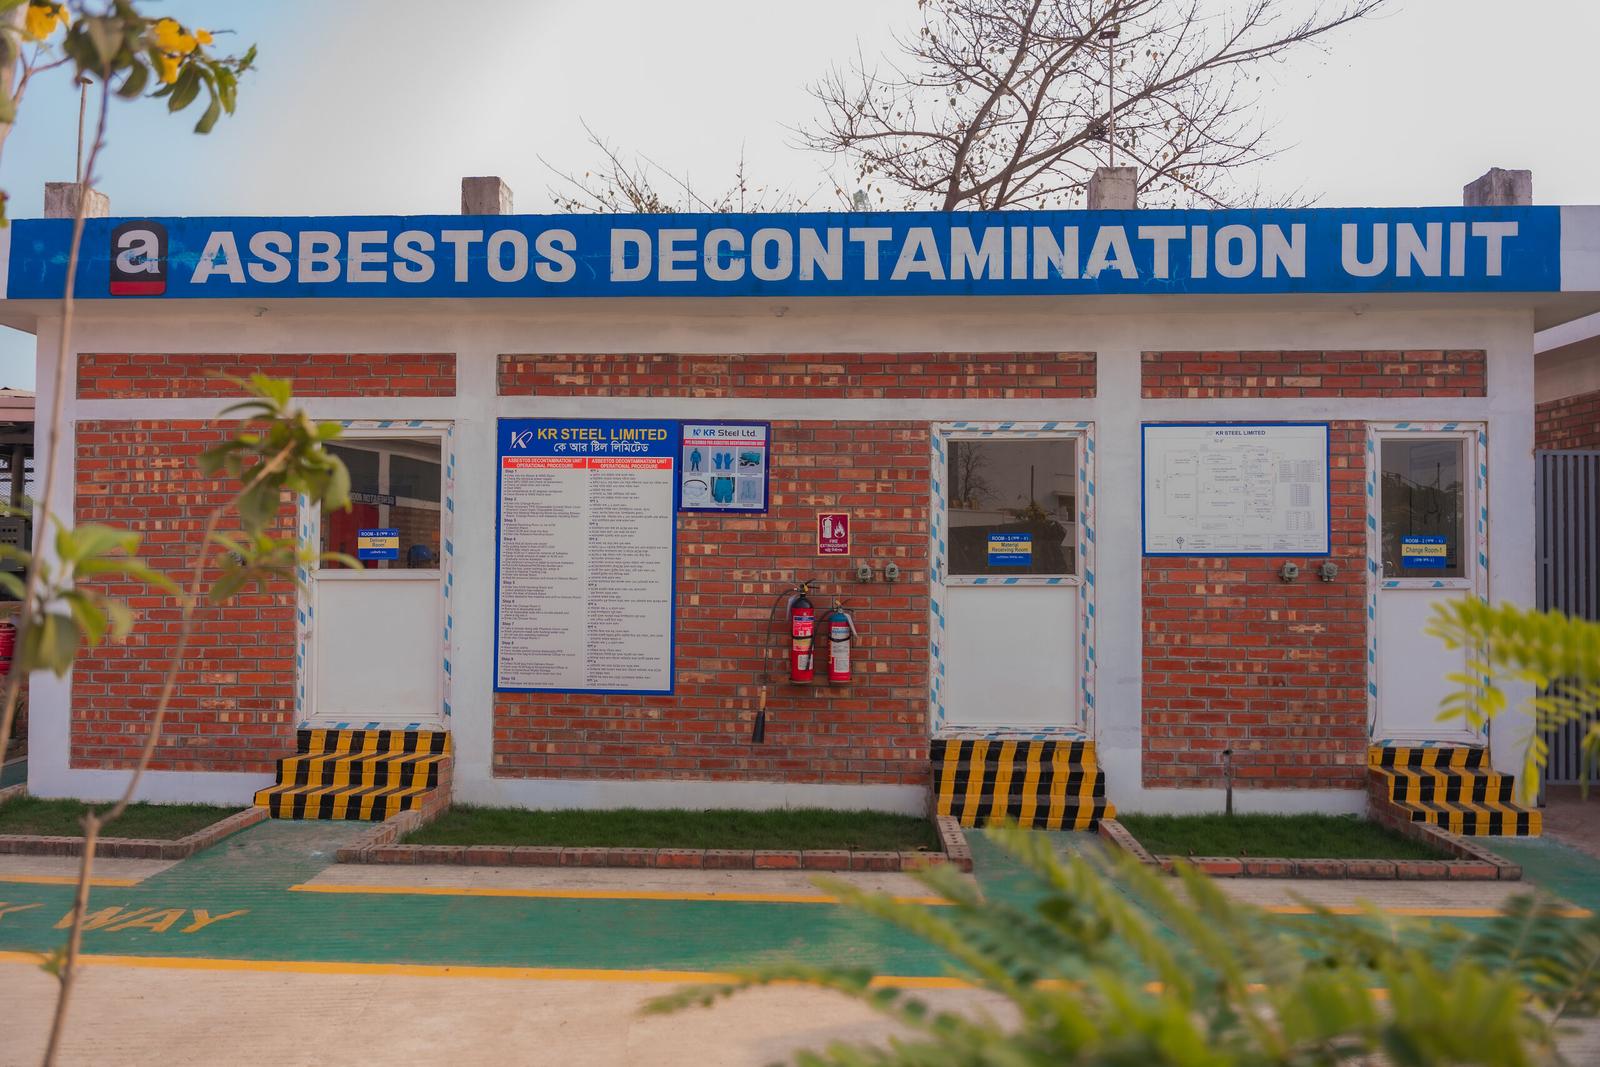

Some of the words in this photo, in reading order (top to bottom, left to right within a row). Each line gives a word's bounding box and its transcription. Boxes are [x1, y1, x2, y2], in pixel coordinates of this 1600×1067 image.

[190, 228, 577, 285] ASBESTOS
[610, 224, 1306, 284] DECONTAMINATION
[1341, 221, 1518, 278] UNIT
[538, 428, 557, 440] KR
[561, 428, 606, 440] STEEL
[610, 429, 667, 441] LIMITED
[718, 429, 739, 437] Steel
[554, 442, 566, 452] কে
[569, 442, 588, 452] আর
[610, 440, 650, 452] লিমিটেড
[54, 906, 252, 933] WAY
